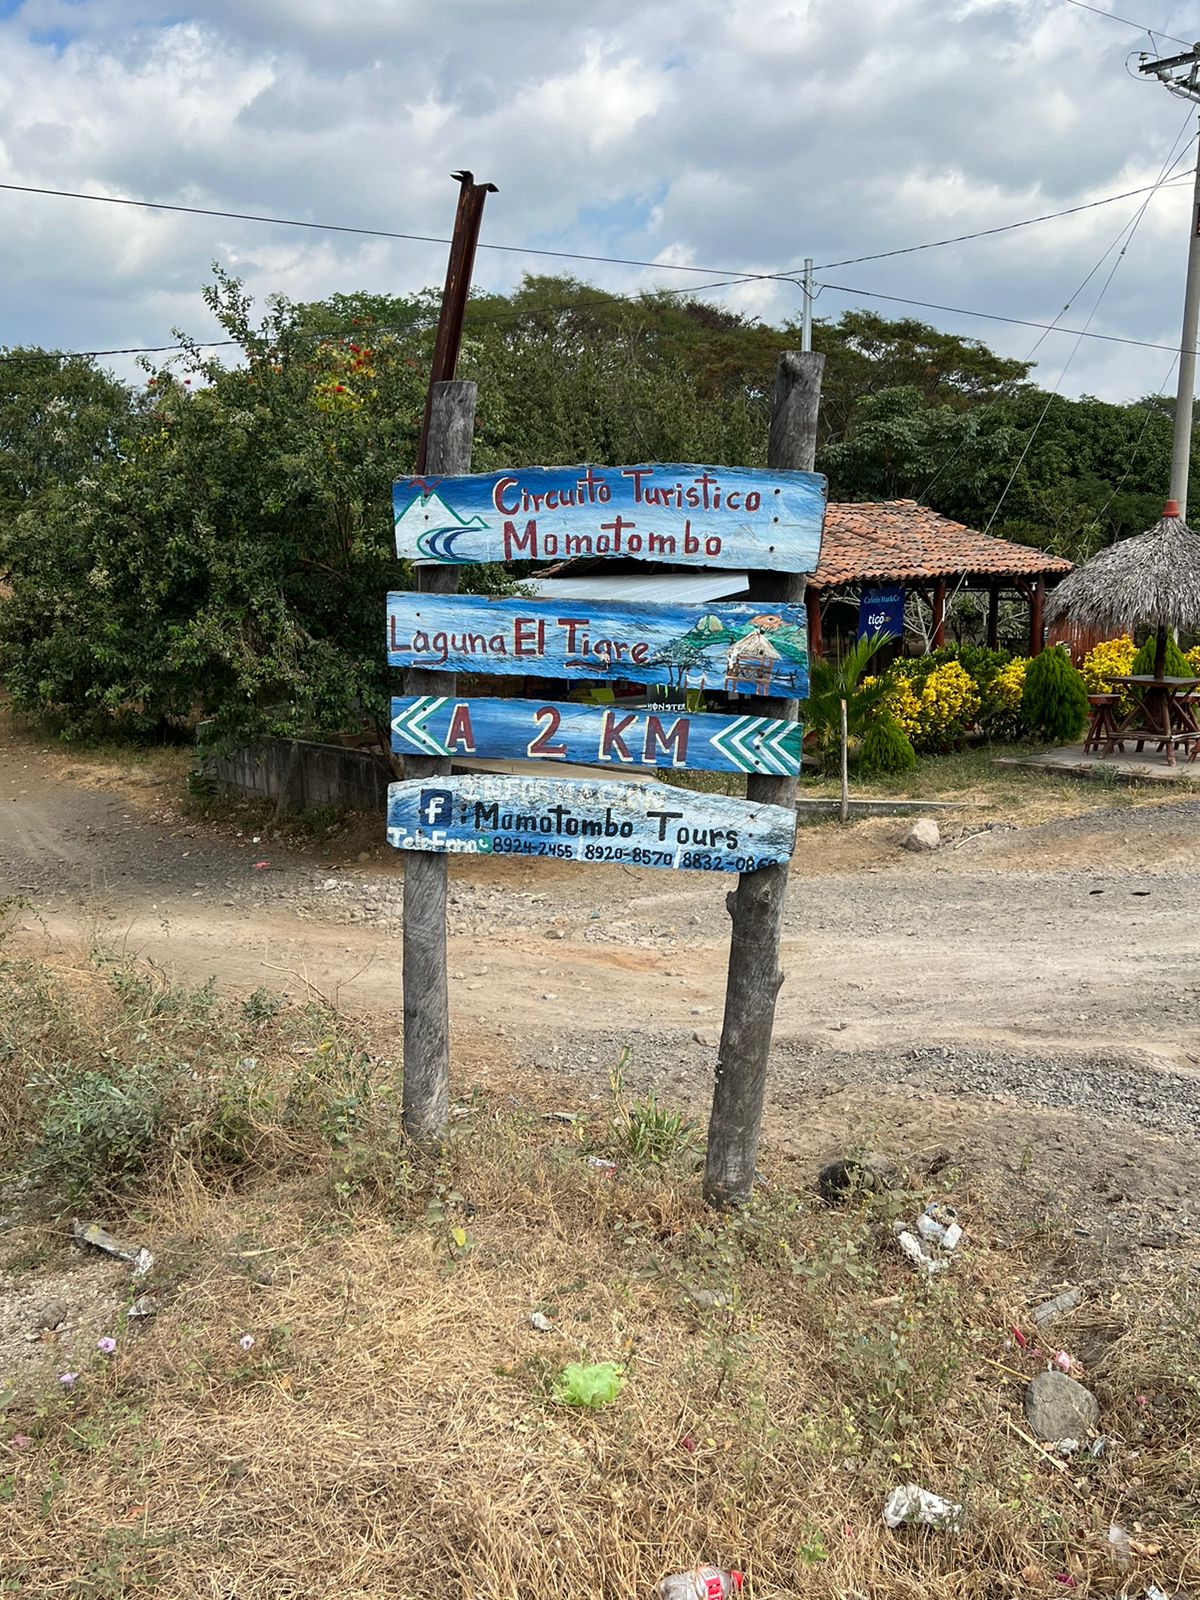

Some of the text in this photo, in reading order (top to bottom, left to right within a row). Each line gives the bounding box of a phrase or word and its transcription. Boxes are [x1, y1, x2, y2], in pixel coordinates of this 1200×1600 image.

[492, 468, 762, 516] Circuito Turistico
[502, 514, 722, 561] Momotombo
[387, 614, 651, 671] Laguna El Tigre
[445, 702, 691, 767] A 2 KM
[491, 836, 573, 858] 8924-2455
[584, 844, 673, 866] 8920-8570
[646, 810, 739, 849] Tours
